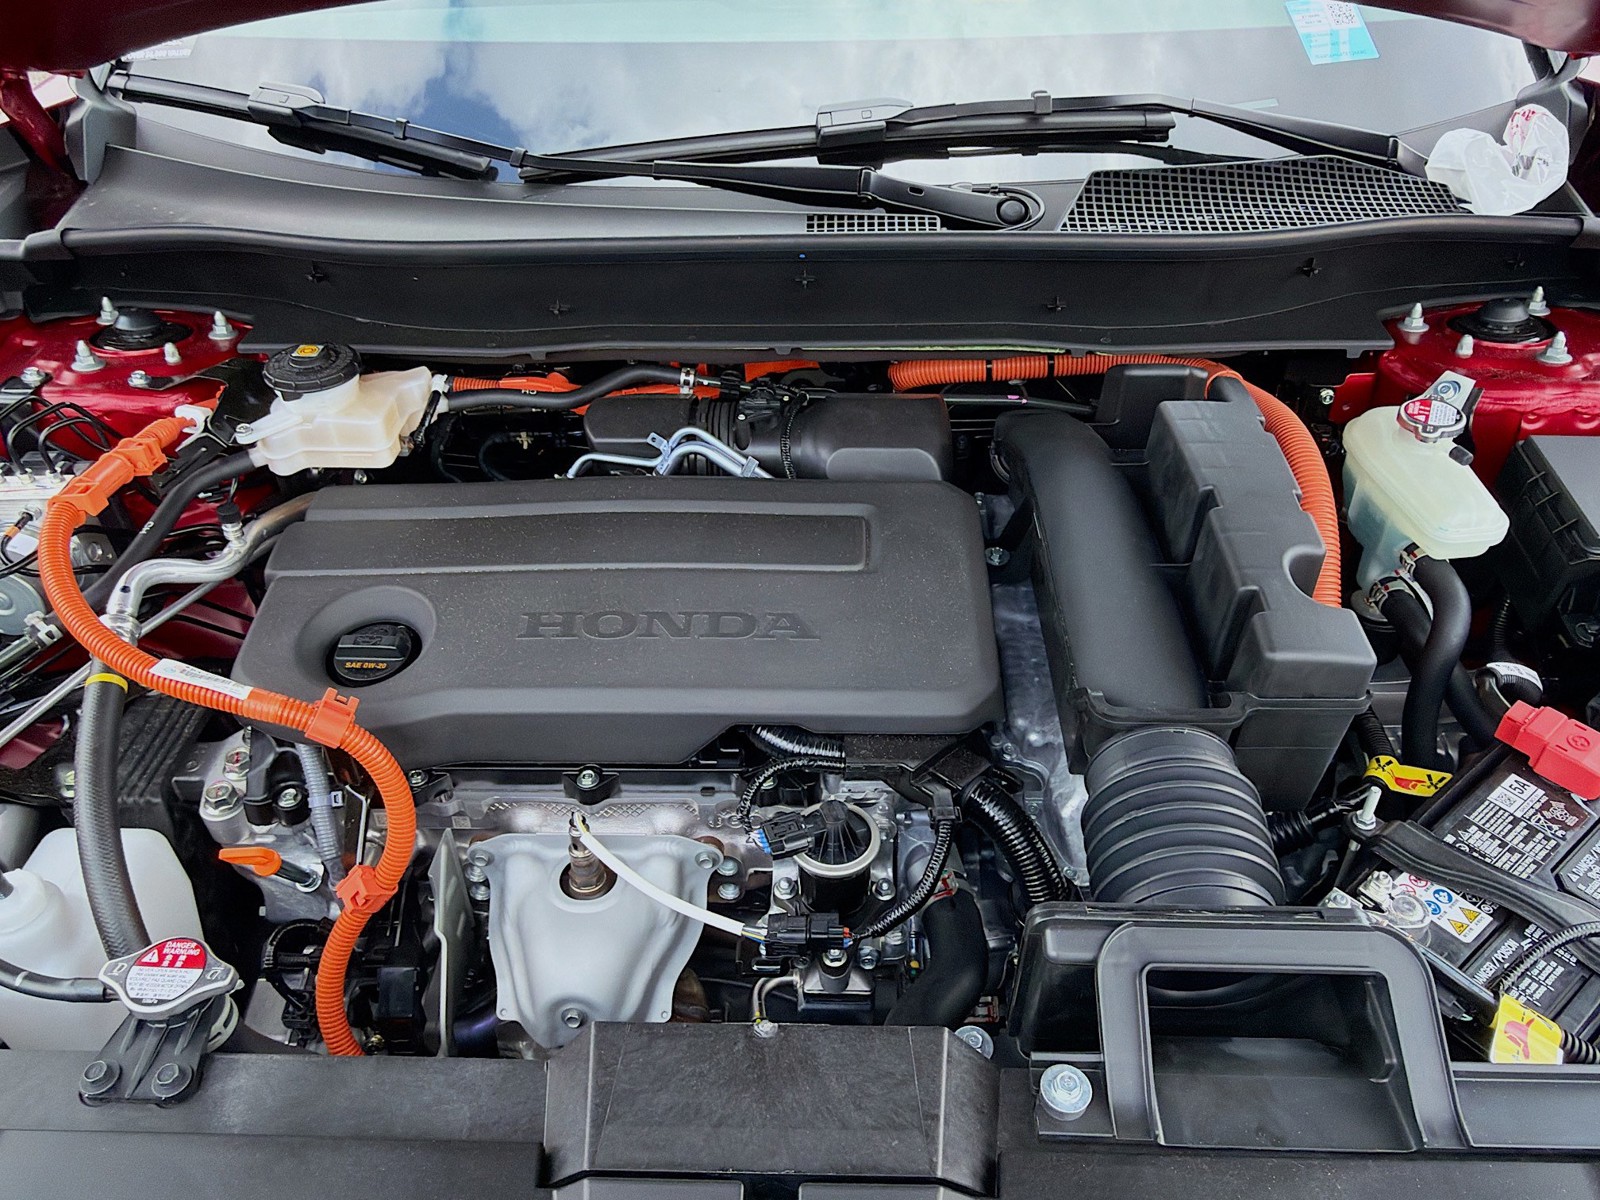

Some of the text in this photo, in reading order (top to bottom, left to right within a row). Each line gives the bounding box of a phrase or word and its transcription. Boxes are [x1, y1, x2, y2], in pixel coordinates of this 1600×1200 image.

[516, 611, 821, 640] HONDA
[1509, 779, 1531, 795] 5A
[166, 941, 198, 949] DANGER
